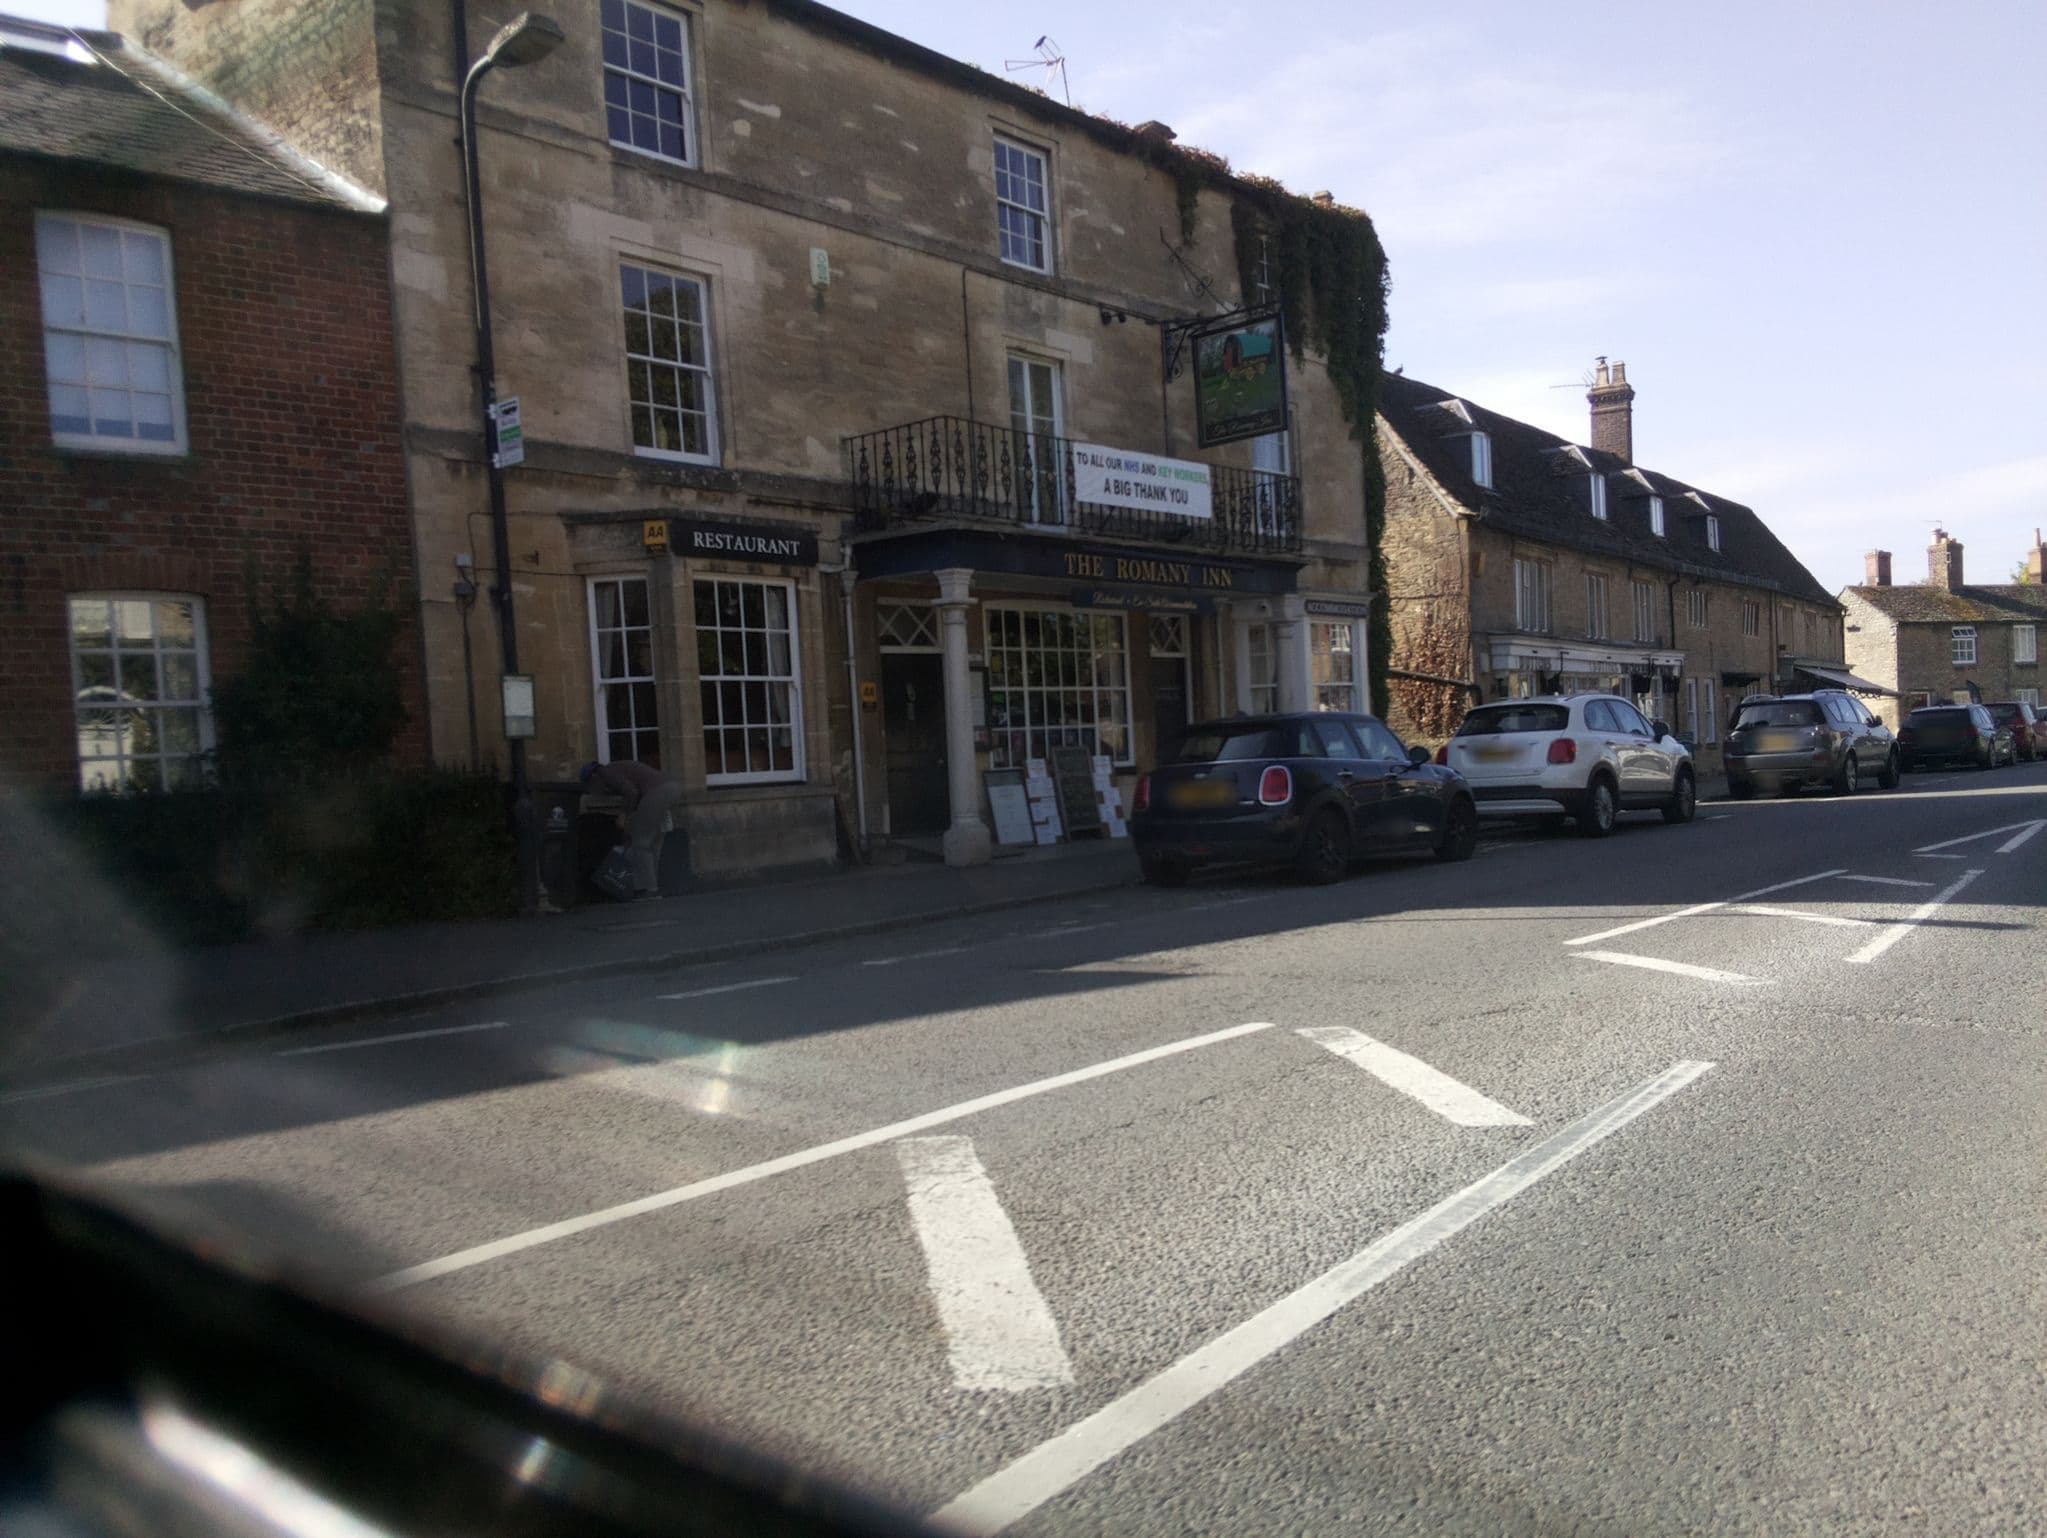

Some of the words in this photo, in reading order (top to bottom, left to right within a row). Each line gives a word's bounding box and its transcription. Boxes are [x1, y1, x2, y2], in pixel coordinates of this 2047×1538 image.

[1077, 452, 1089, 465] TO
[1090, 454, 1104, 468] ALL
[1106, 457, 1123, 471] OUR
[1124, 459, 1140, 474] NHS
[1141, 463, 1157, 476] AND
[1158, 465, 1172, 479] KEY
[1103, 477, 1112, 494] A
[1114, 479, 1131, 497] BIG
[1133, 482, 1168, 502] THANK
[1169, 488, 1188, 505] YOU
[693, 531, 800, 556] RESTAURANT
[1064, 553, 1105, 577] THE
[1116, 558, 1192, 585] ROMANY
[1201, 567, 1233, 587] INN
